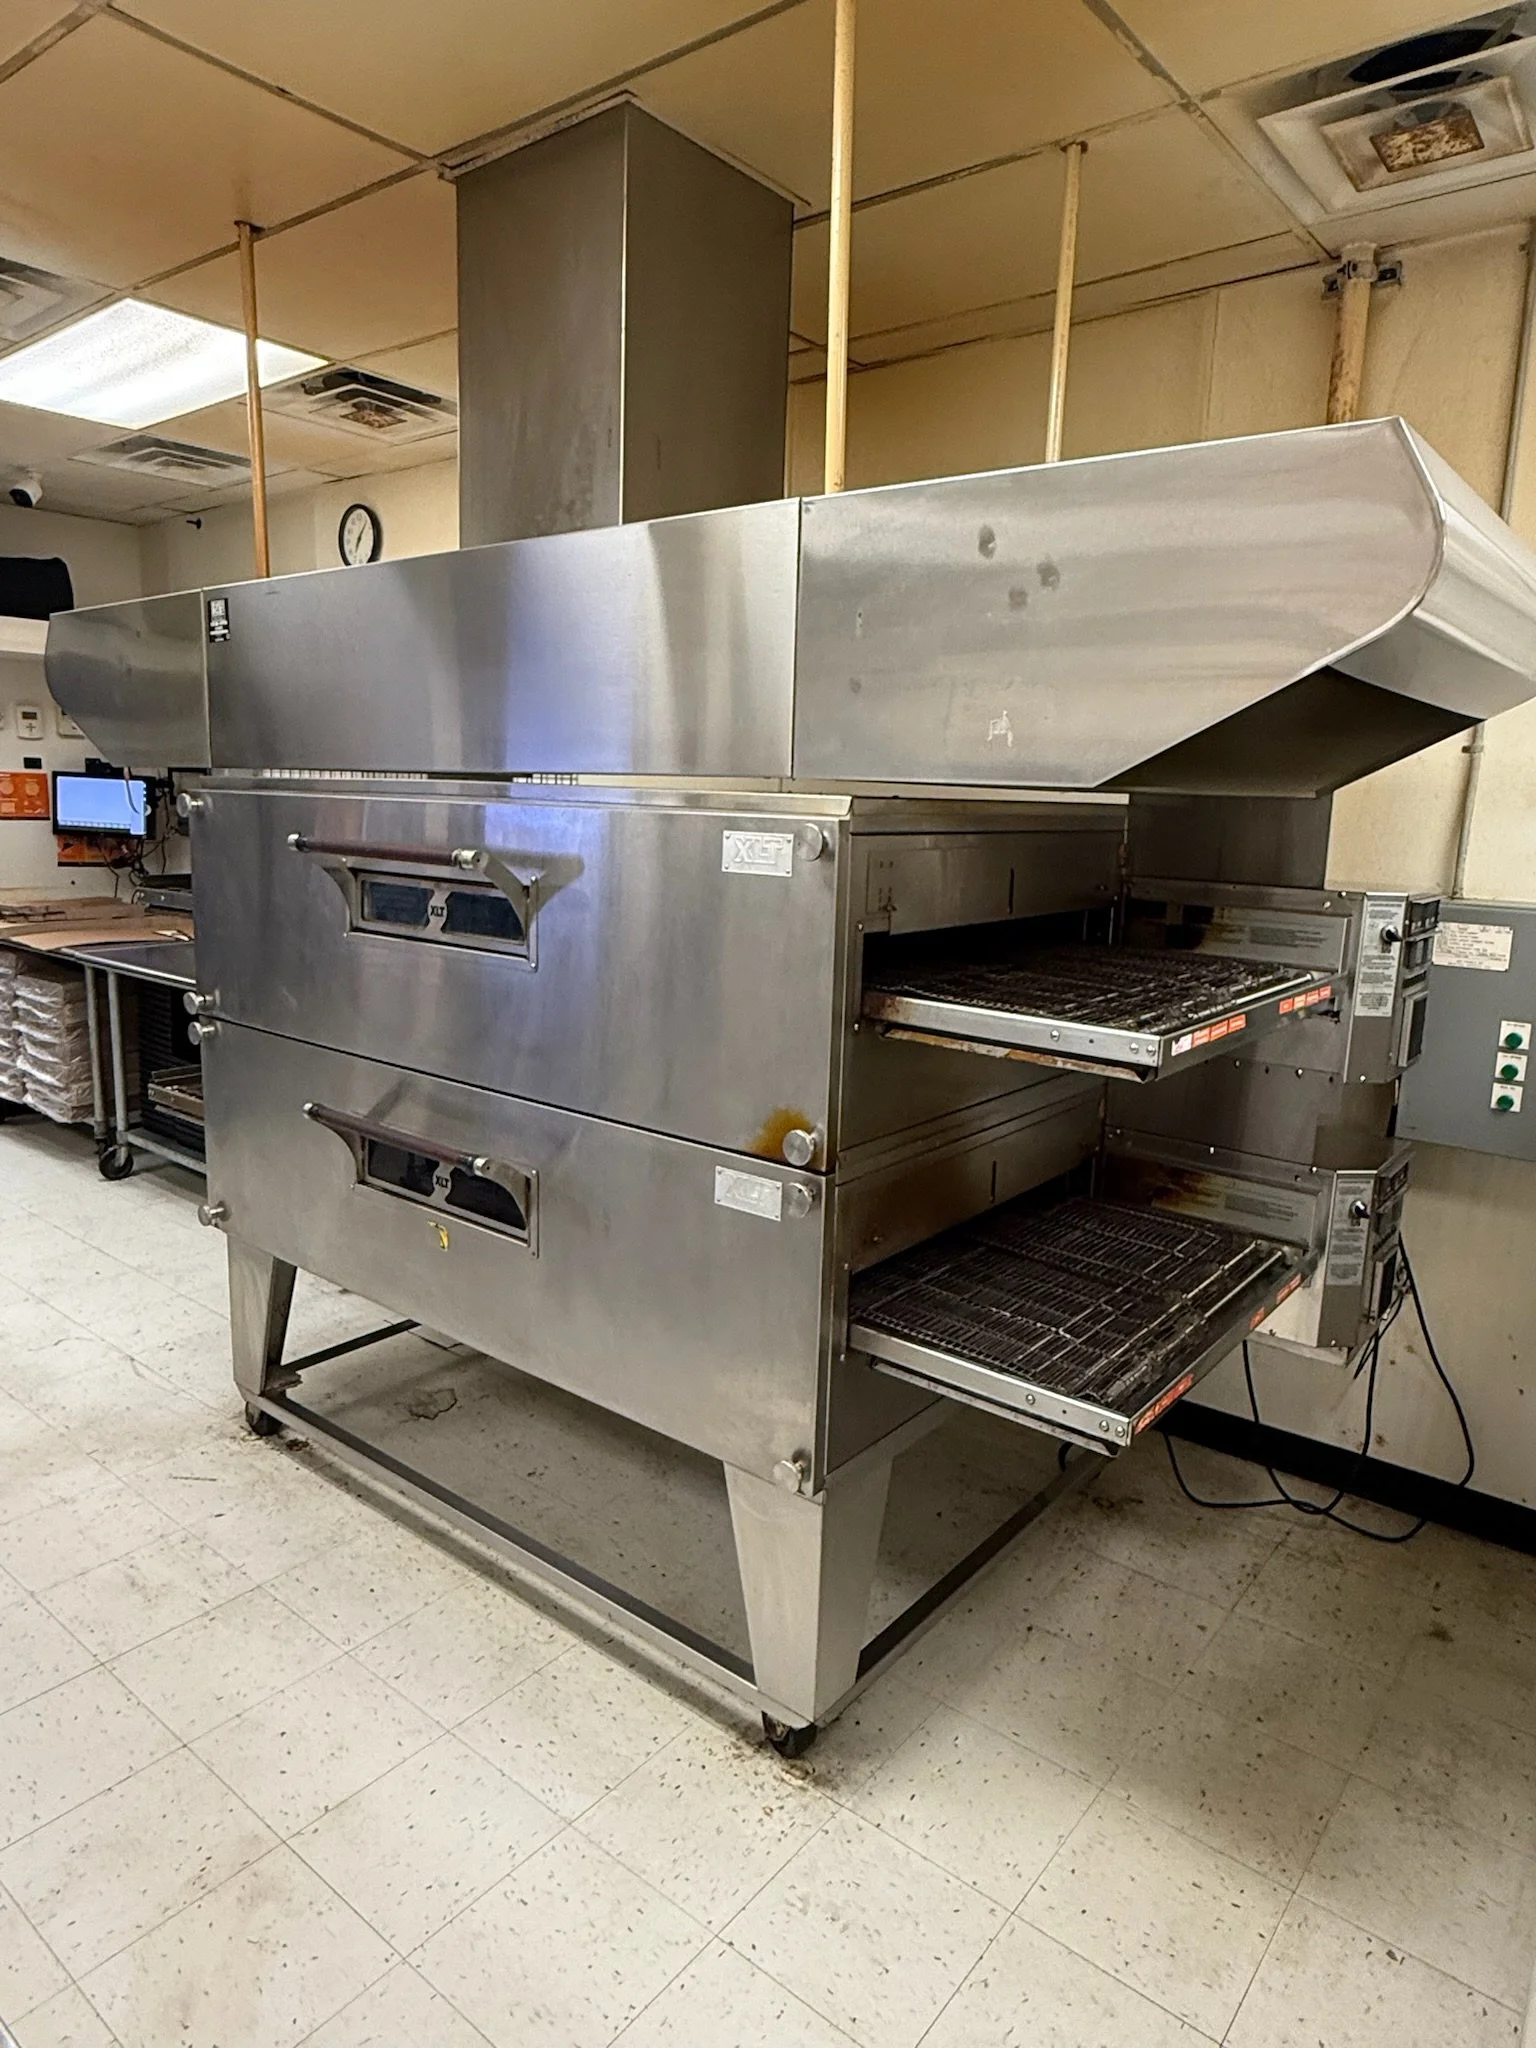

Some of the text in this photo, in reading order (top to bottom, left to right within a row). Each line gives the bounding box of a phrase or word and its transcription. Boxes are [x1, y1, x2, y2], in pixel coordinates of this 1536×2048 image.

[733, 835, 784, 865] XLT
[430, 905, 445, 917] XLT
[435, 1174, 450, 1188] XLT
